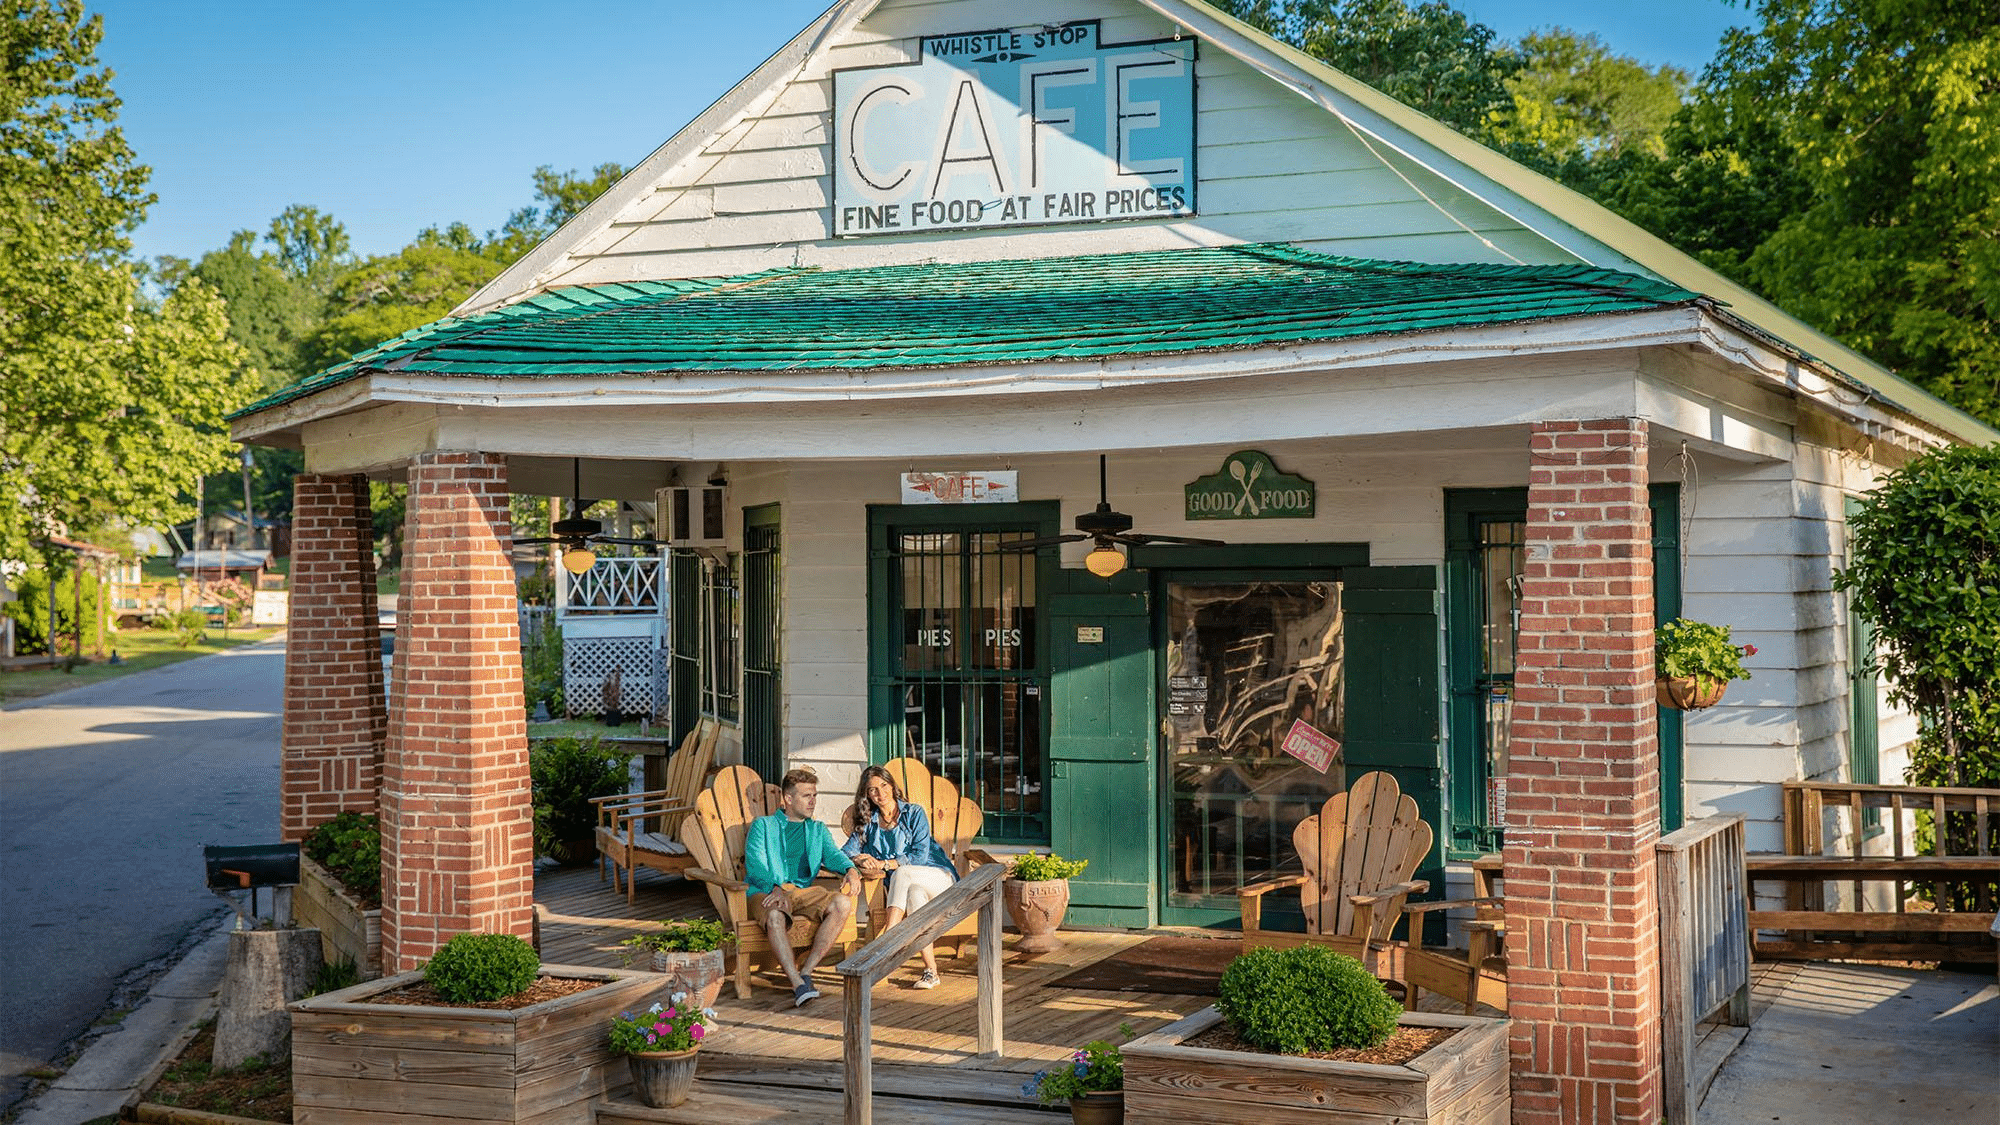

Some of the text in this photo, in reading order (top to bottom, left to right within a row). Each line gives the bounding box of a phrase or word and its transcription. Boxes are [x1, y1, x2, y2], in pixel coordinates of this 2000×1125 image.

[931, 27, 1088, 56] WHISTLE STOP
[840, 49, 1185, 202] CAFE
[843, 186, 1185, 230] FINE FOOD AT FAIR PRICES
[934, 476, 984, 499] CAFE
[1190, 489, 1311, 512] GOOD FOOD
[918, 629, 1020, 647] PIES PIES
[1288, 733, 1328, 767] OPEN
